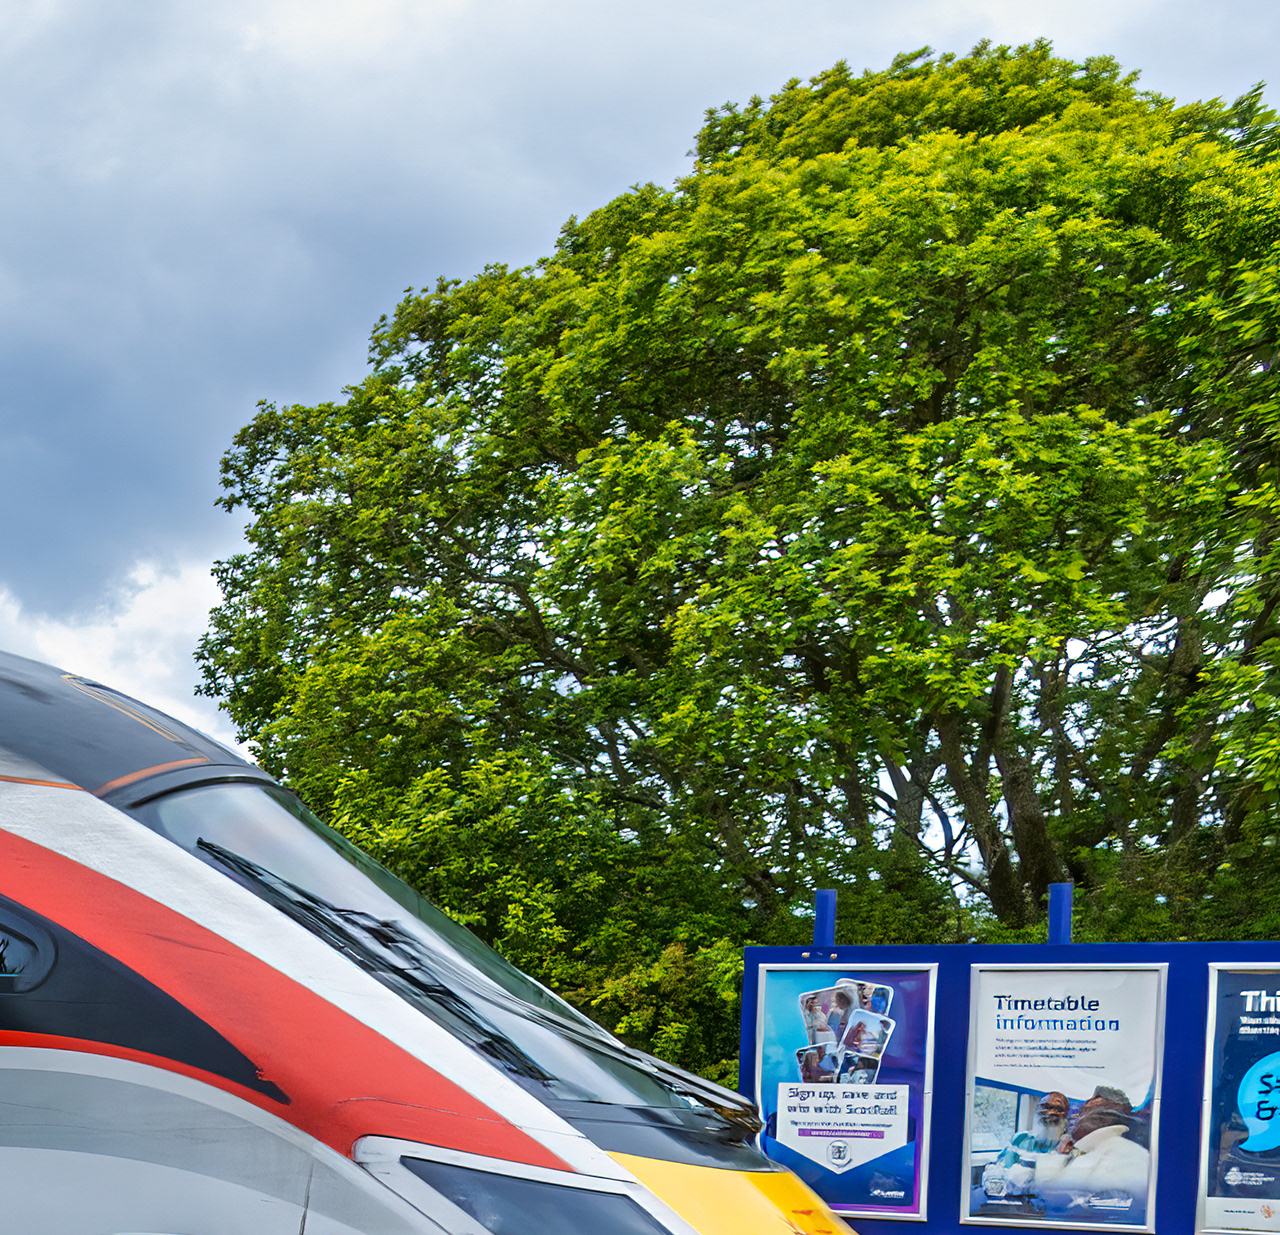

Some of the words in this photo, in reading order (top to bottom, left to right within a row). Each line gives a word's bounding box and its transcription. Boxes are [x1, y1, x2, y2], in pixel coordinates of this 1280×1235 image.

[993, 994, 1100, 1012] Timetable
[995, 1014, 1120, 1032] information
[788, 1087, 815, 1101] Sign
